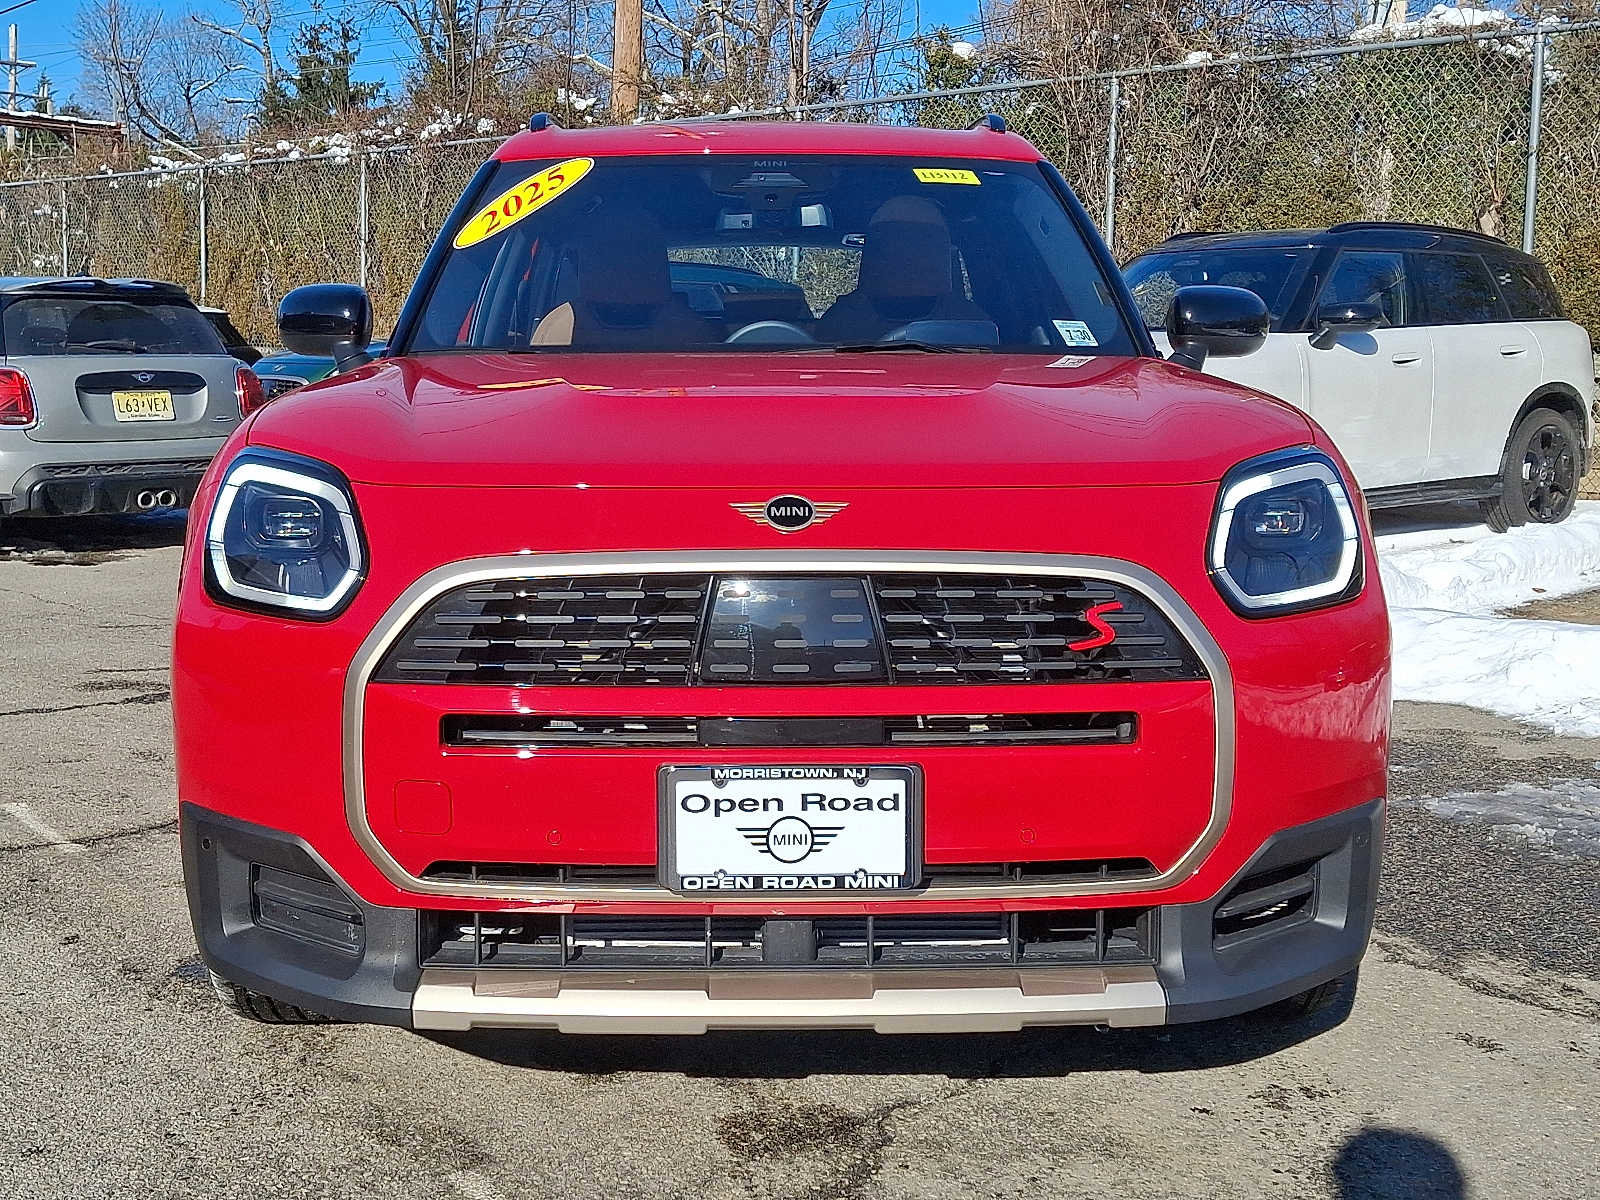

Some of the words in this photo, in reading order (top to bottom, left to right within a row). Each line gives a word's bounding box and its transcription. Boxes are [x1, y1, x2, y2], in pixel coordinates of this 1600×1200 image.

[481, 166, 565, 235] 2025
[770, 506, 809, 517] MINI
[1067, 601, 1124, 651] S
[714, 768, 838, 779] MORRISTOWN,
[843, 767, 867, 779] NJ
[680, 793, 784, 818] Open
[800, 792, 900, 812] Road
[773, 833, 808, 846] MINI
[682, 875, 754, 890] OPEN
[762, 875, 836, 889] ROAD
[844, 875, 900, 889] MINI
